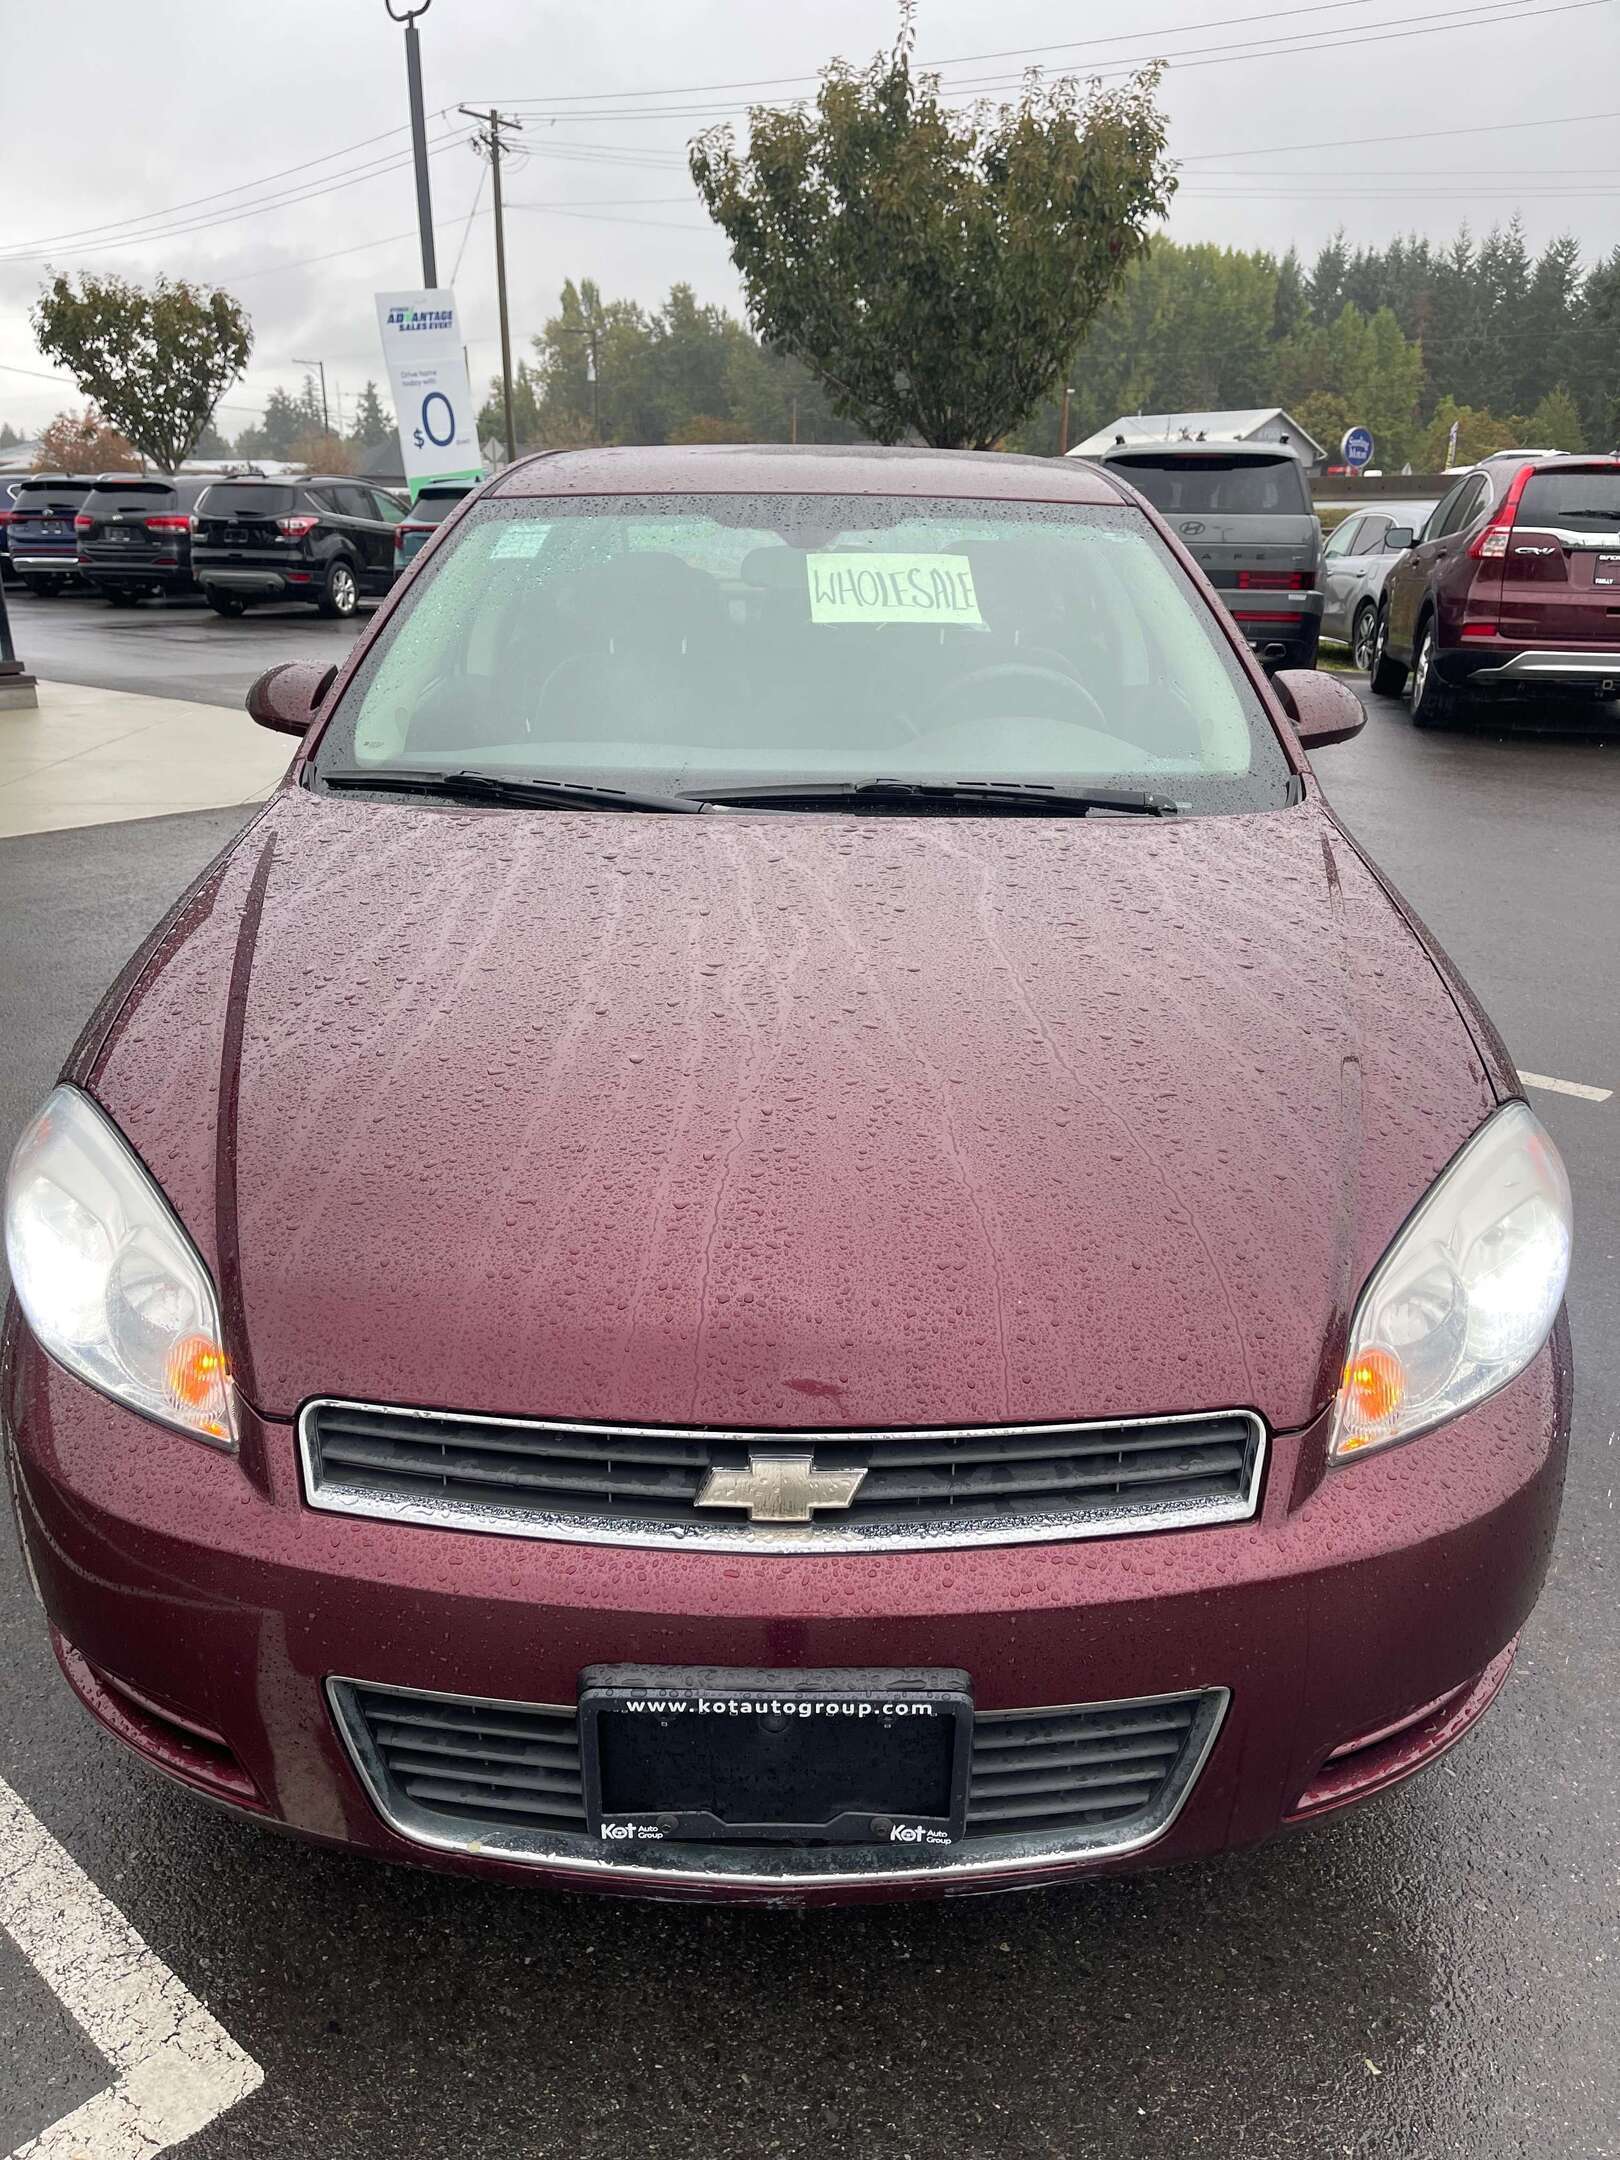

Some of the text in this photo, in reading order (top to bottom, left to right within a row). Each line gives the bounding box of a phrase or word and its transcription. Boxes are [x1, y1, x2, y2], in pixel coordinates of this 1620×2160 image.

[387, 310, 453, 324] ADVANTAGE
[399, 323, 427, 332] SALES
[814, 567, 976, 611] WHOLESALE
[626, 1698, 932, 1718] www.kotautogroup.com
[600, 1822, 637, 1840] Kot
[637, 1832, 664, 1840] Group
[890, 1824, 948, 1842] Kot Auto
[926, 1836, 952, 1845] Group
